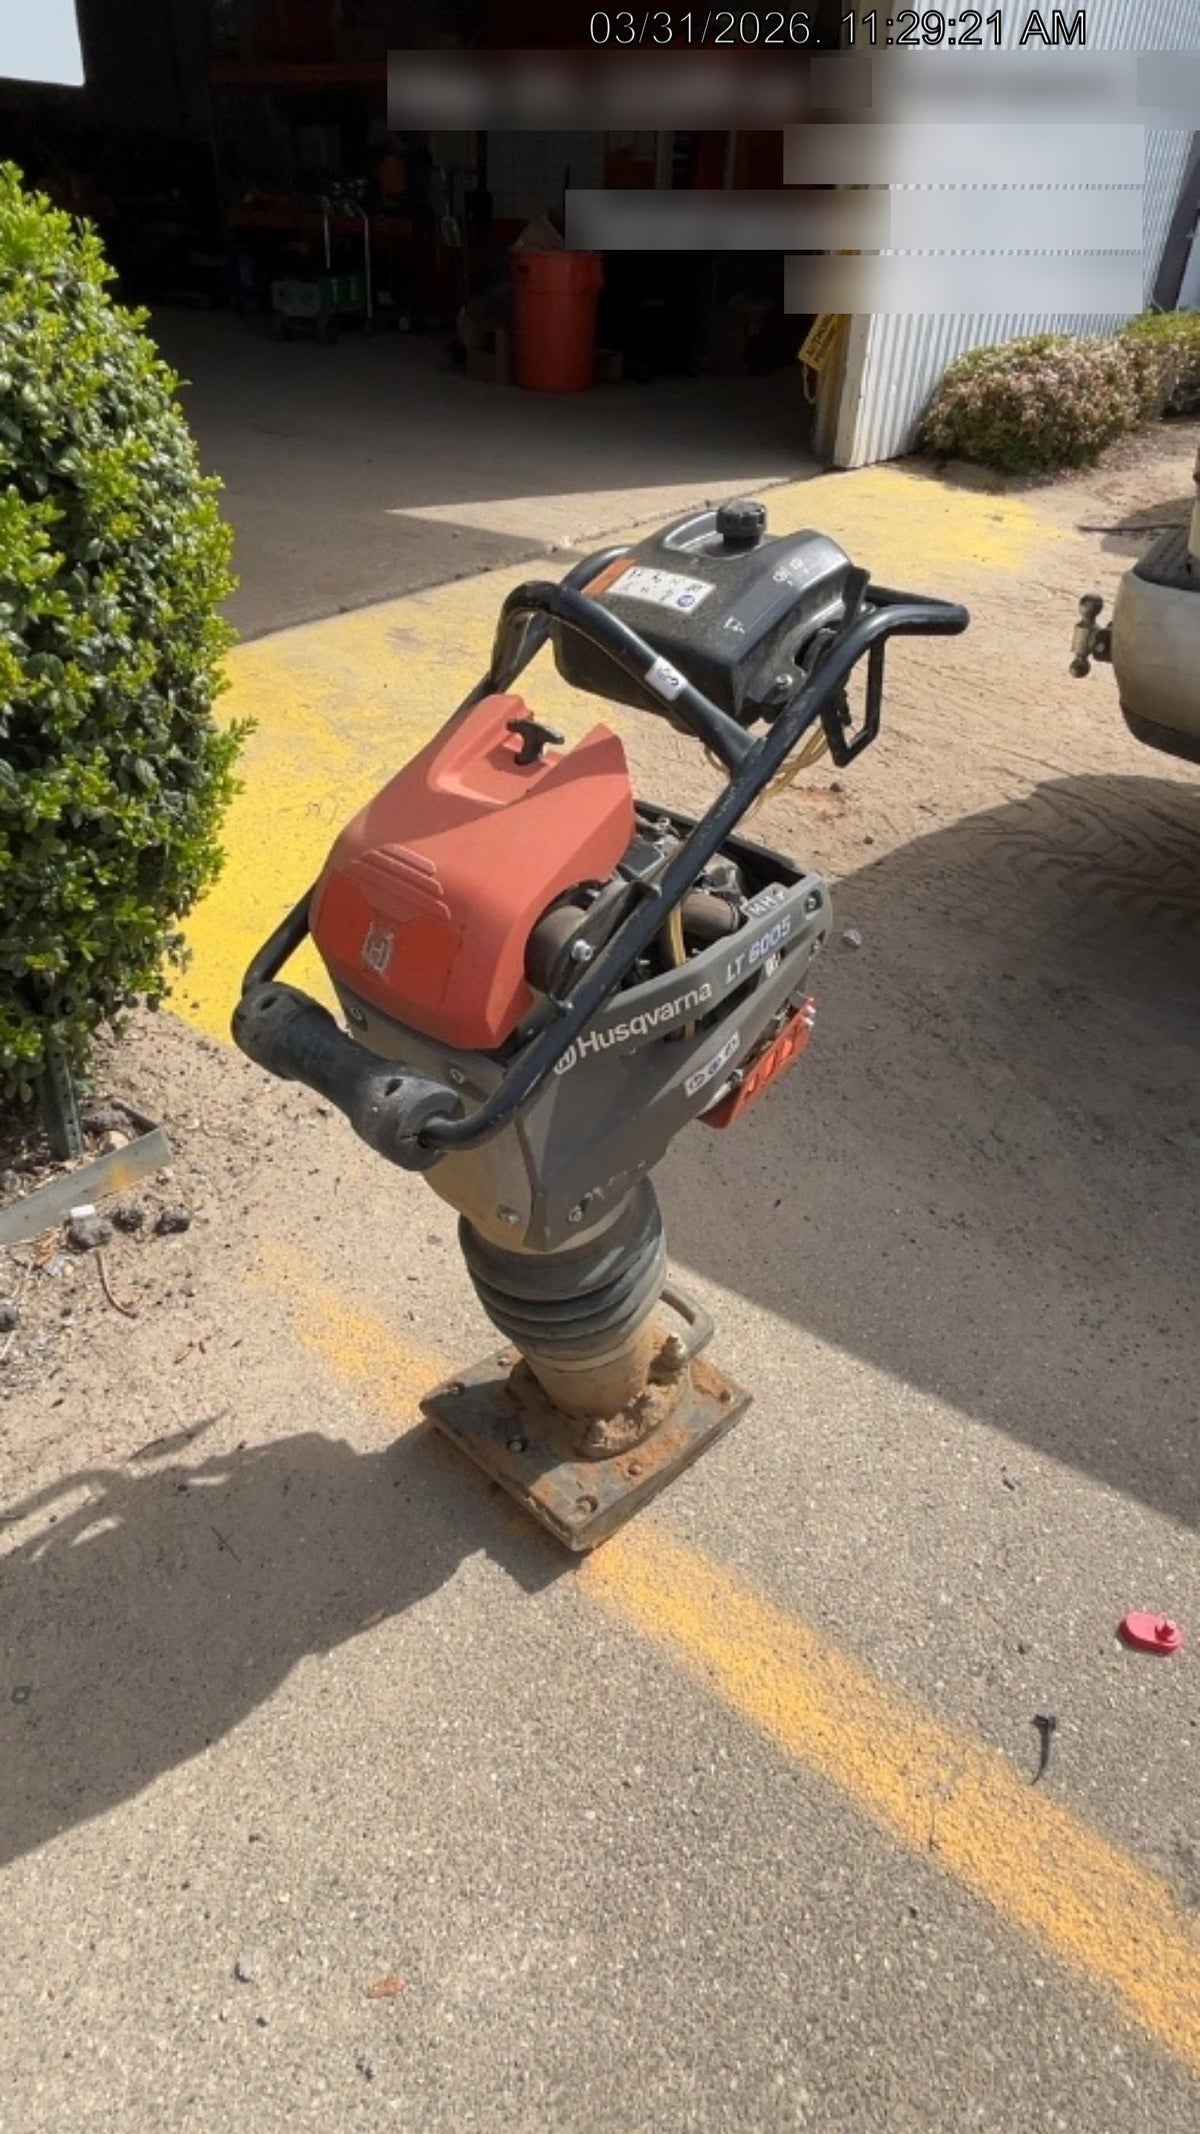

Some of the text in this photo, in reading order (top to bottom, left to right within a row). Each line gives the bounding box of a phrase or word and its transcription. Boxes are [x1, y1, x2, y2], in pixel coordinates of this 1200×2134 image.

[726, 914, 791, 984] LT 6005
[576, 983, 713, 1059] Husqvarna
